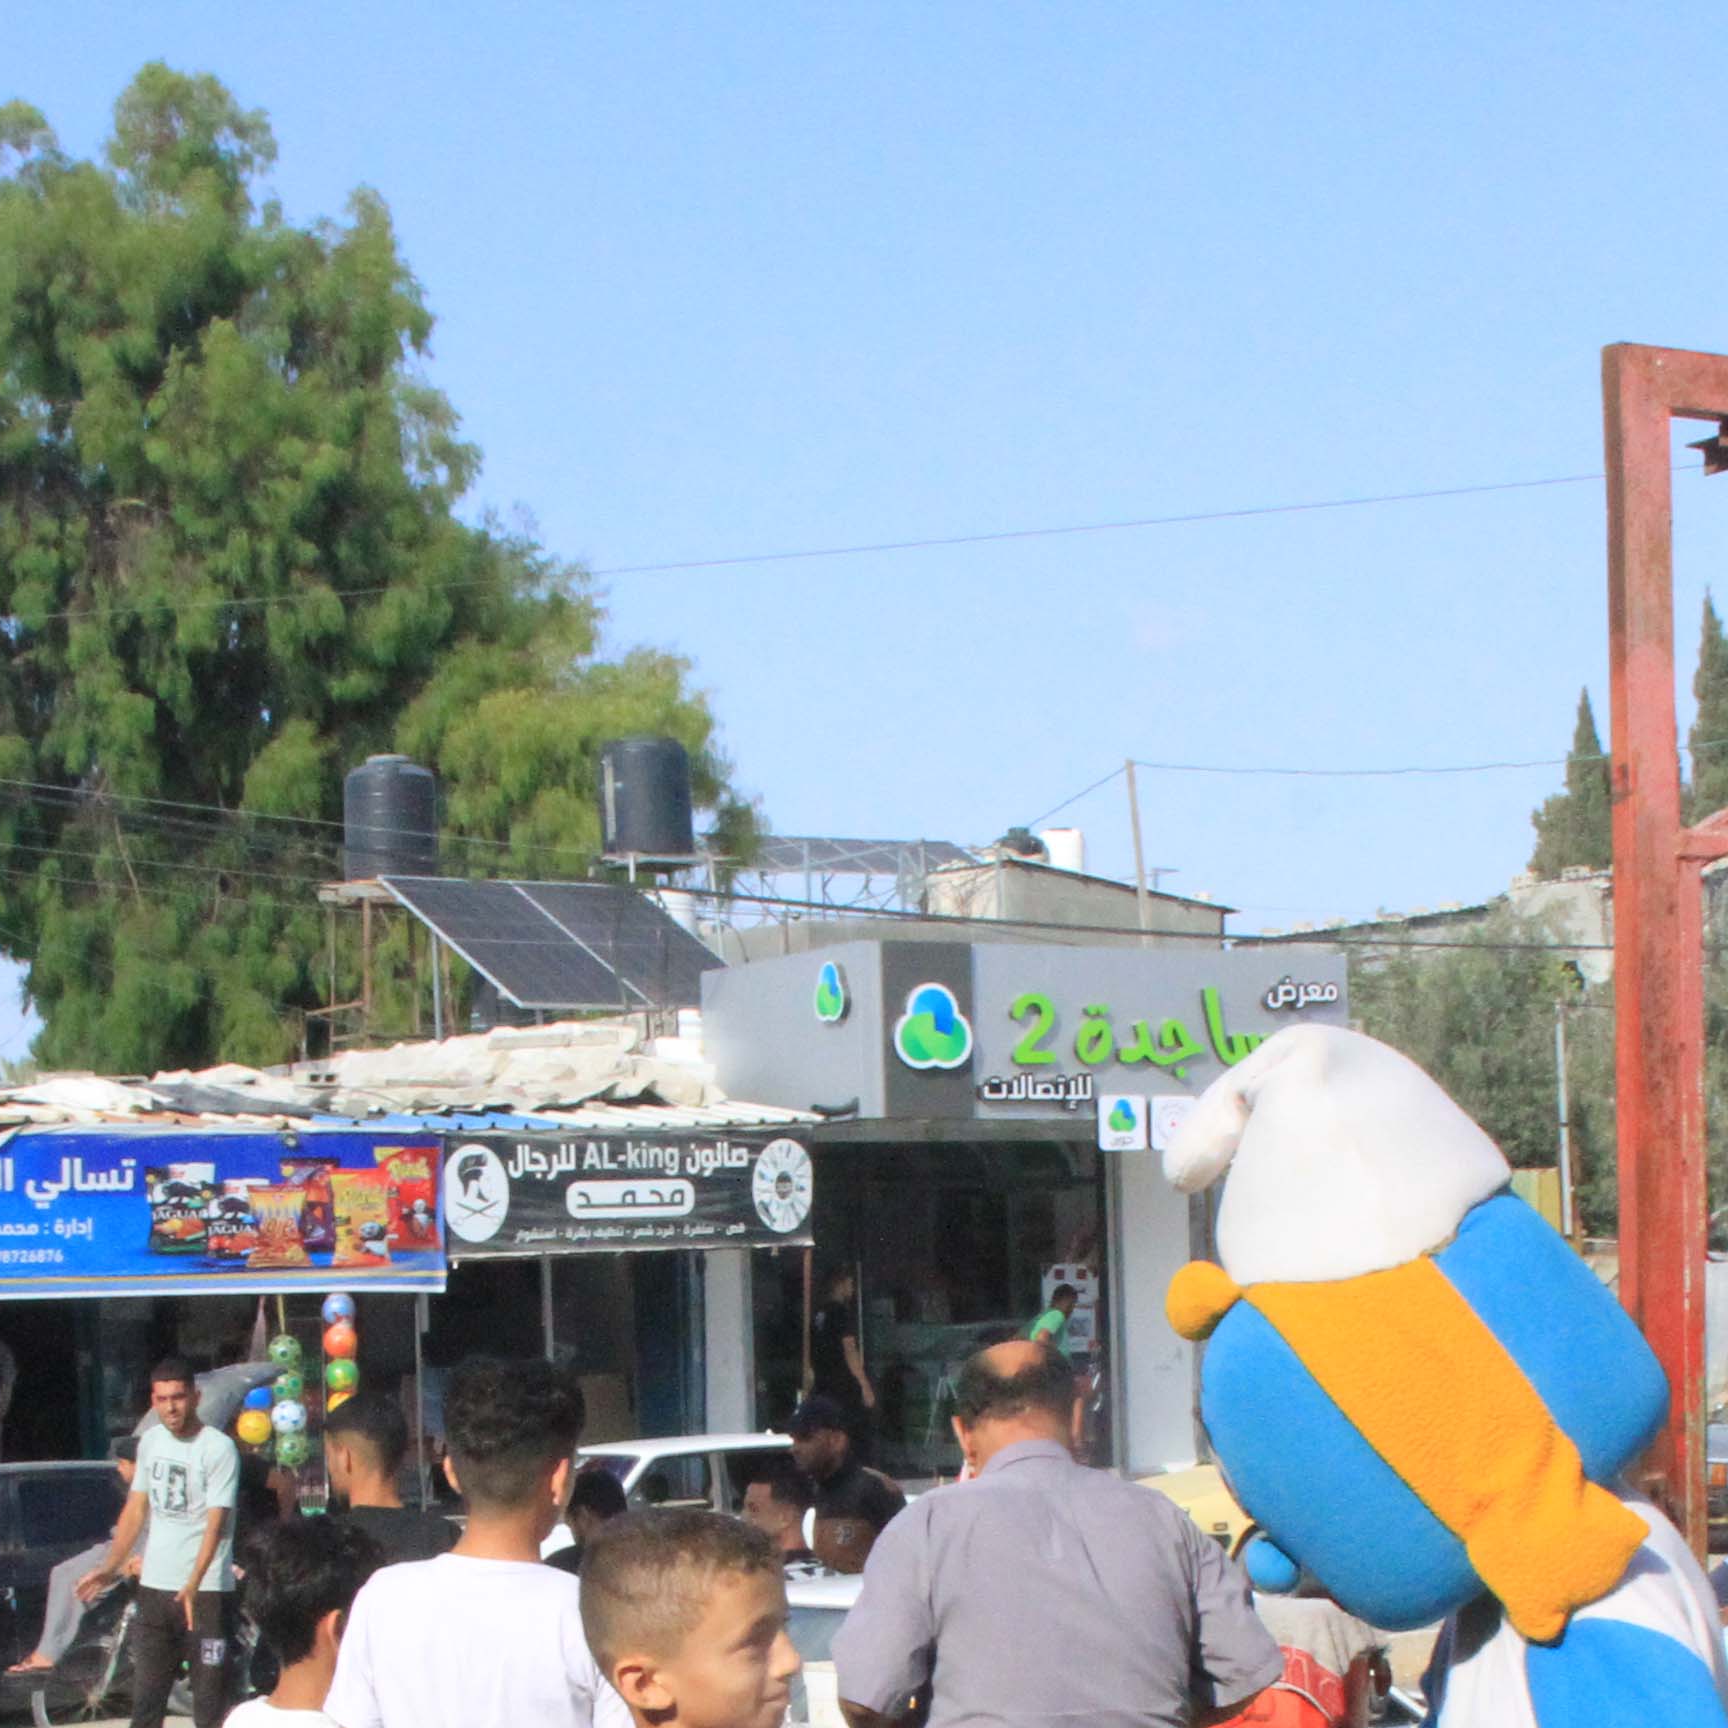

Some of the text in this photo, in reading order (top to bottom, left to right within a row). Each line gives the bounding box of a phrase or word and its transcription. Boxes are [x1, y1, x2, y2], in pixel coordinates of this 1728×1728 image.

[1267, 976, 1338, 1009] معرض
[1011, 992, 1056, 1065] 2
[508, 1141, 749, 1180] صالون AL-king للرجال
[25, 1157, 136, 1209] تسالي
[577, 1188, 685, 1209] محمد
